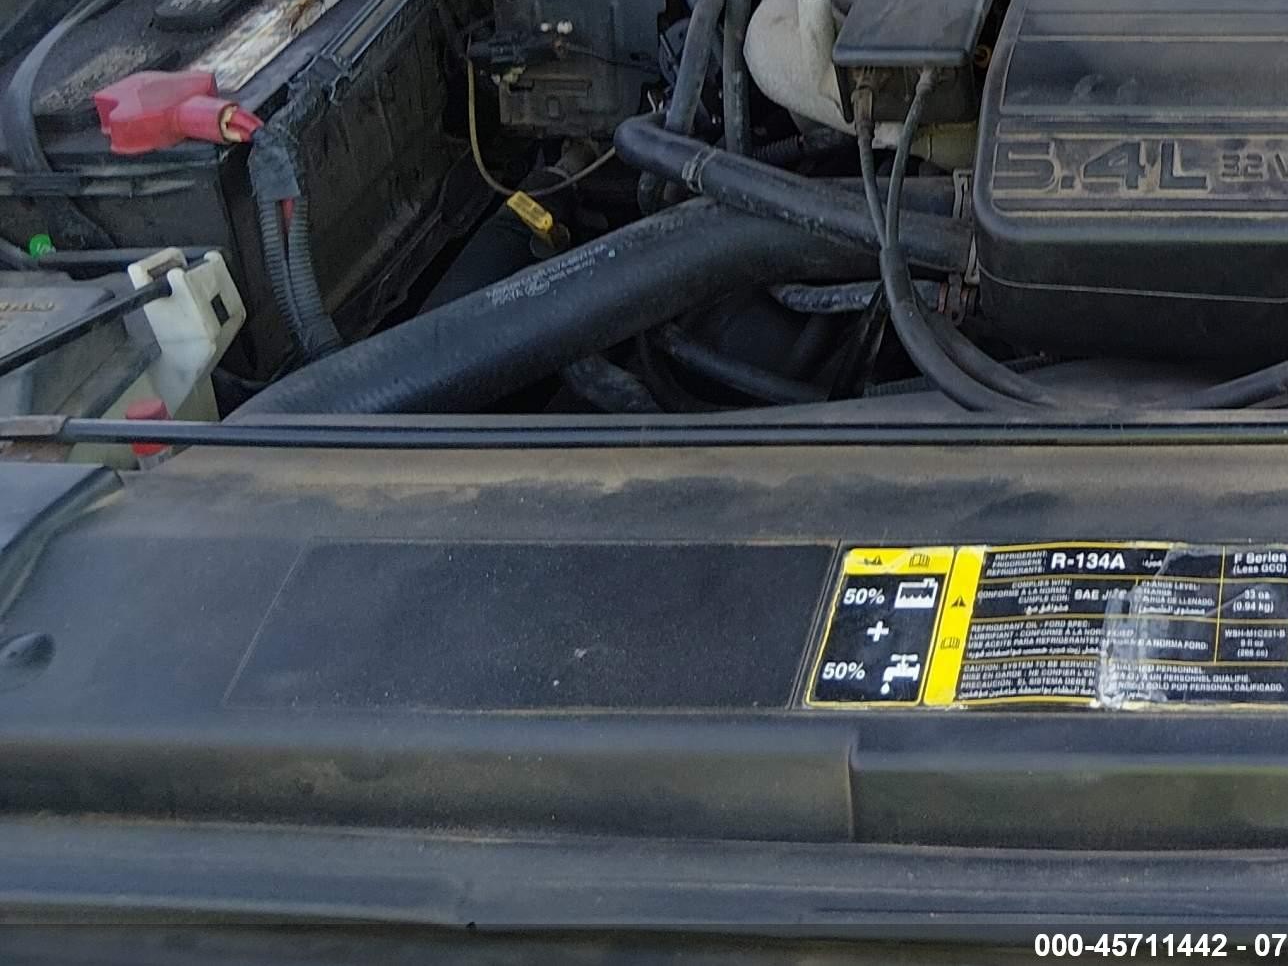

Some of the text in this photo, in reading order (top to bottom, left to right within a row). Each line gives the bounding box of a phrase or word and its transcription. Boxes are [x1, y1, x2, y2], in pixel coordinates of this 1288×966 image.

[991, 139, 1209, 191] 5.4L
[1221, 151, 1264, 182] 32
[1051, 552, 1126, 570] R-134A
[1234, 551, 1287, 564] F Series
[1232, 565, 1259, 575] (Less
[843, 588, 885, 605] 50%
[1074, 589, 1100, 600] SAE
[822, 661, 865, 680] 50%
[1190, 683, 1233, 692] PERSONAL
